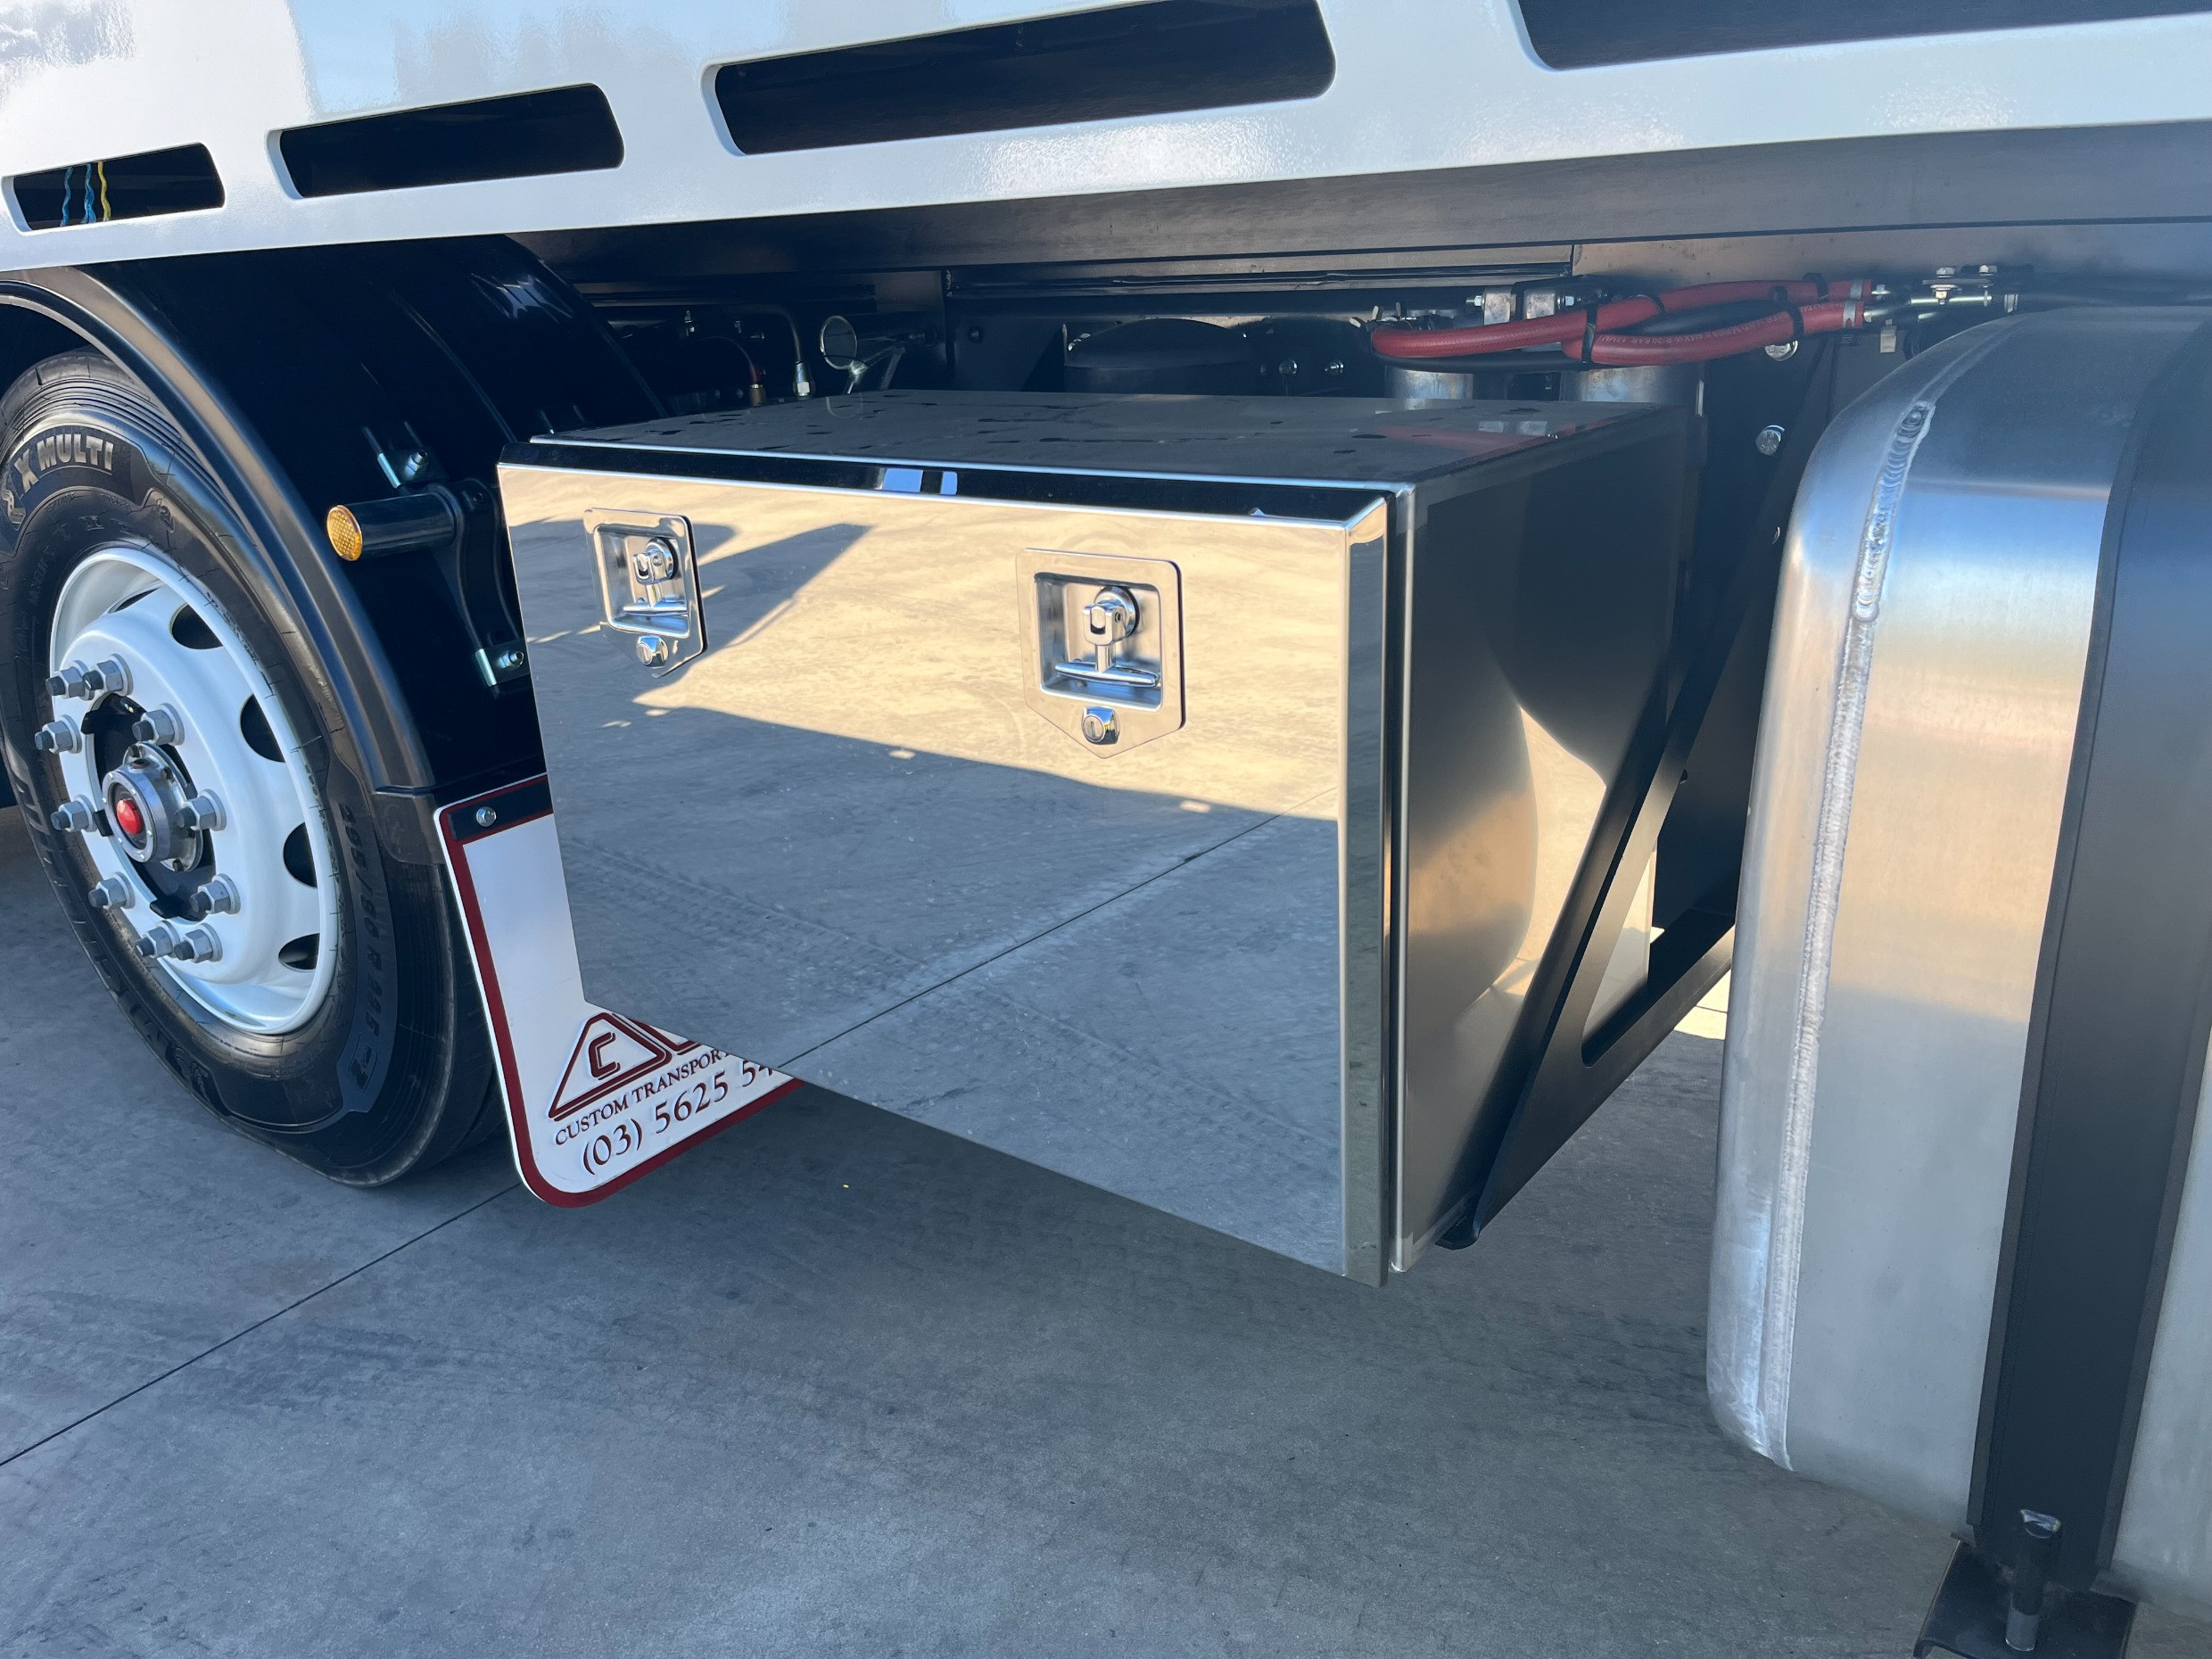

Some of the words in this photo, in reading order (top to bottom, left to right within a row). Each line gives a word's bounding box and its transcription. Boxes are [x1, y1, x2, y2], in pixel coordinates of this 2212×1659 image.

[13, 449, 38, 494] X
[37, 433, 114, 472] MULTI
[555, 1094, 629, 1146] CUSTOM
[631, 1048, 730, 1104] TRANSPOR
[582, 1118, 643, 1176] (03)
[655, 1069, 729, 1134] 5625
